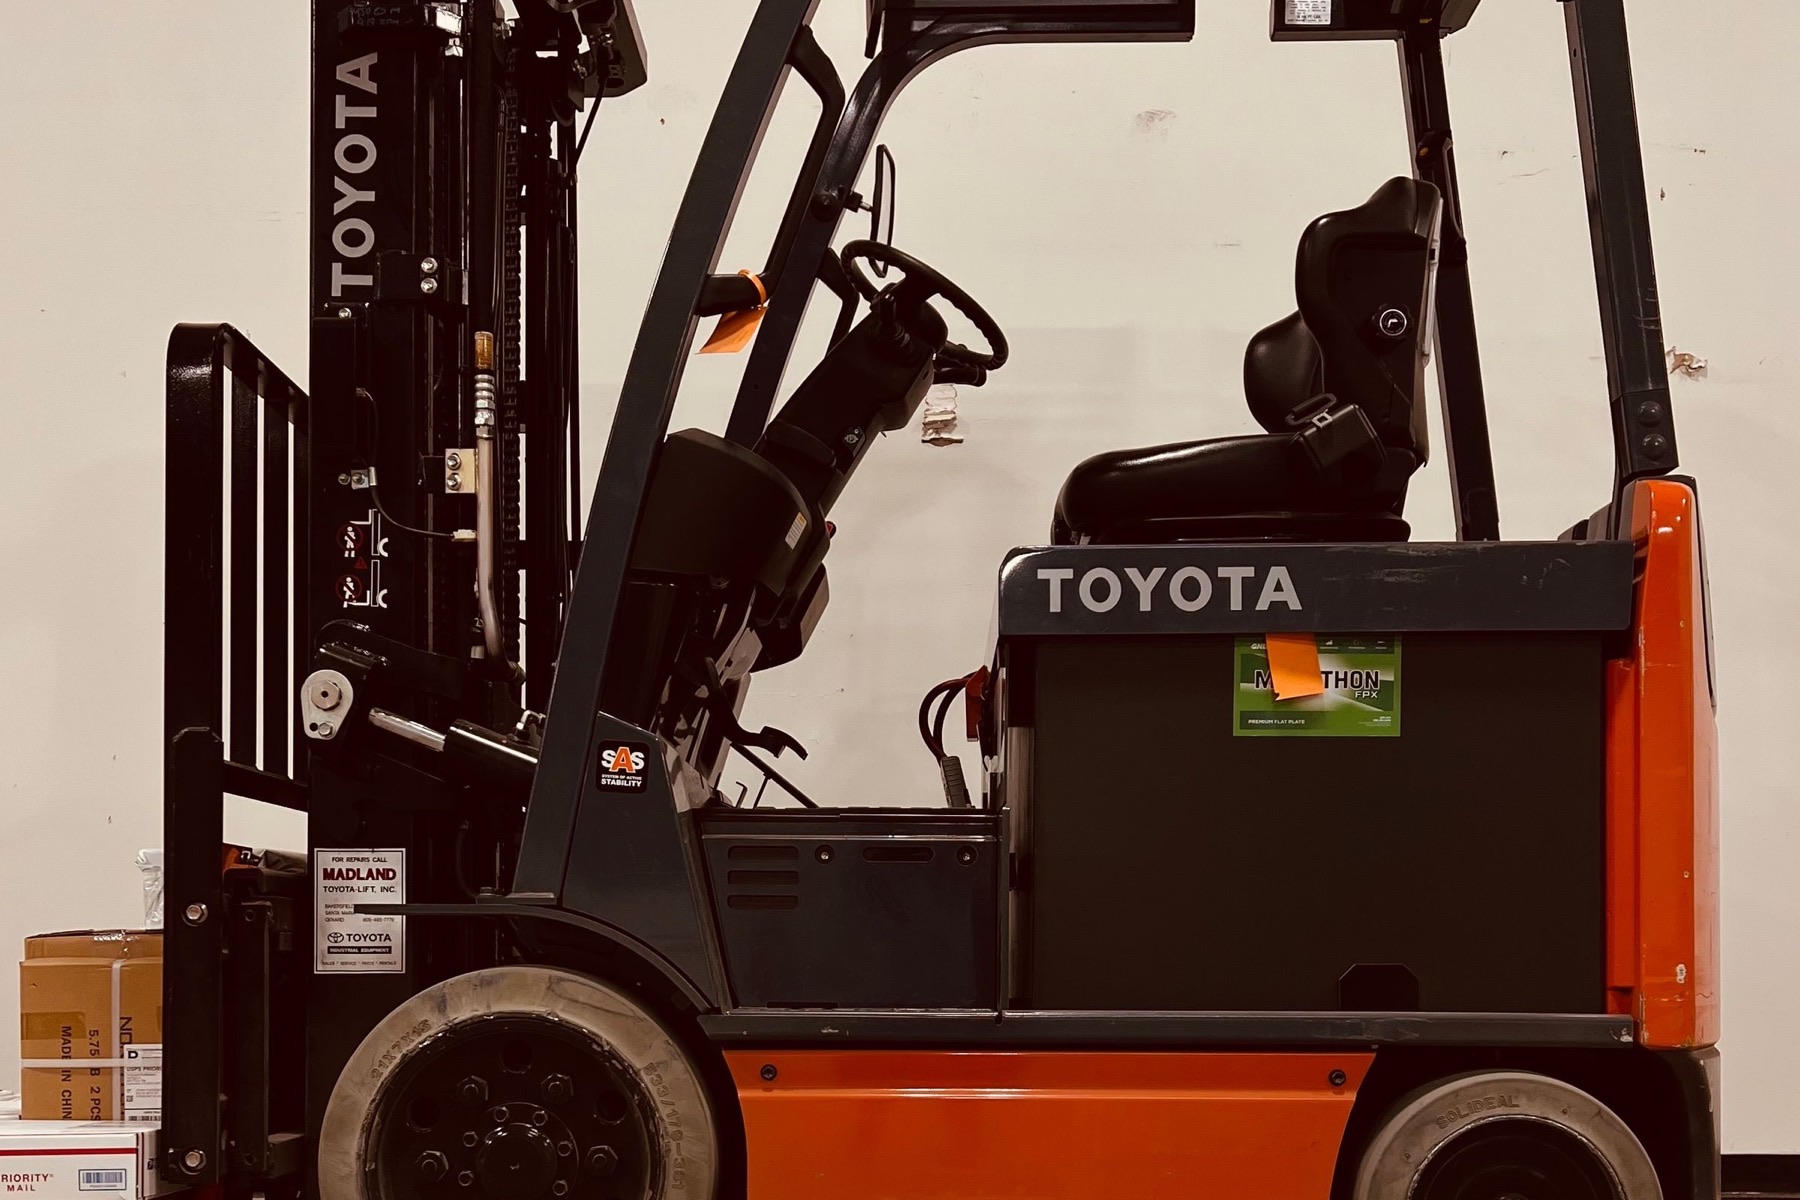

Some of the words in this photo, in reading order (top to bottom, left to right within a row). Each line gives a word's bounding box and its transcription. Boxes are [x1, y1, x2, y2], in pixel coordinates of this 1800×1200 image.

[332, 52, 378, 297] TOYOTA
[1037, 566, 1302, 613] TOYOTA
[1254, 670, 1380, 690] MTHON
[1355, 690, 1378, 699] FPX
[601, 746, 645, 773] SAS
[601, 779, 642, 787] STABILITY
[323, 868, 397, 880] MADLAND
[346, 934, 392, 942] TOYOTA
[61, 1026, 72, 1060] MADE
[88, 1029, 100, 1057] 5.75
[61, 1070, 71, 1082] IN
[90, 1086, 101, 1094] 2
[61, 1089, 73, 1120] CHIN
[1436, 1095, 1520, 1129] SOLIDEAL
[1, 1174, 49, 1183] RIORITY
